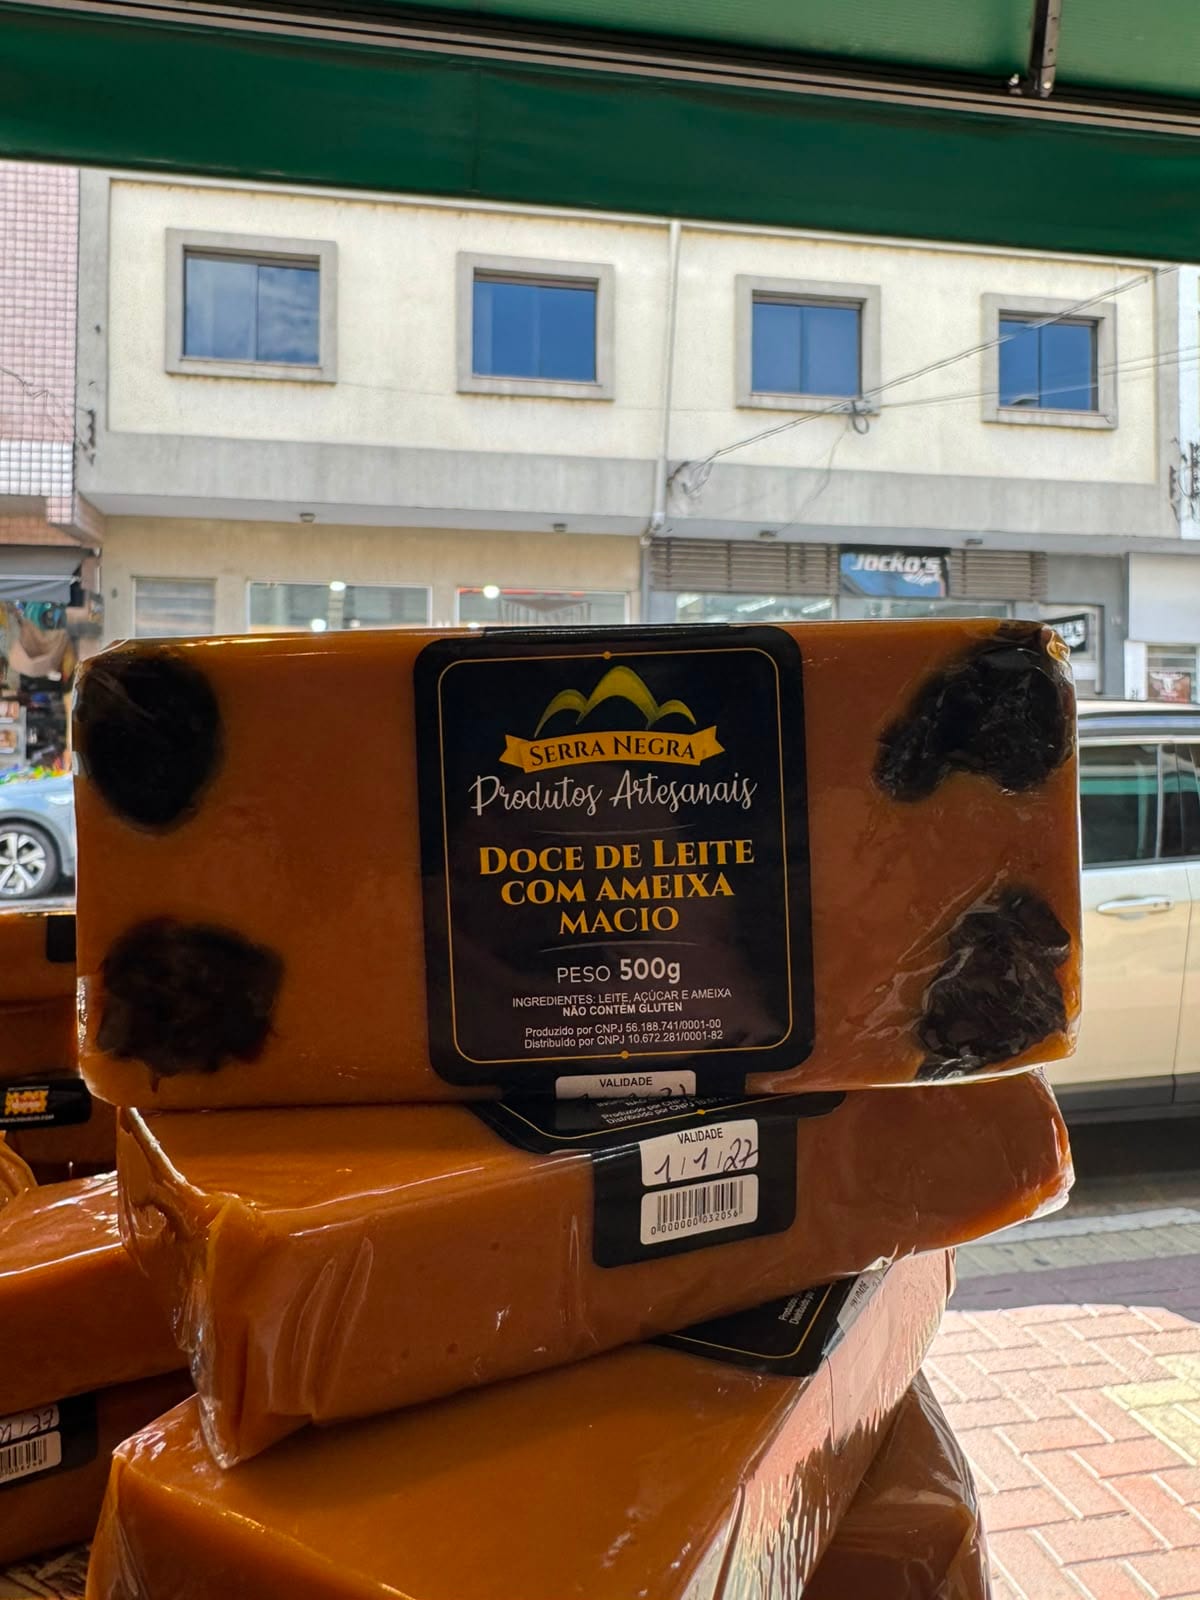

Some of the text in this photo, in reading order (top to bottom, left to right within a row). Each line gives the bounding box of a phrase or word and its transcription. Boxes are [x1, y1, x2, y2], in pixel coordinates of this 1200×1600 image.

[529, 735, 696, 767] SERRA NEGRA
[468, 769, 758, 817] Produtos Artesanais
[479, 839, 755, 875] DOCE DE LEITE
[501, 872, 735, 905] COM AMEIXA
[559, 906, 680, 935] MACIO
[557, 957, 681, 984] PESO 500g
[512, 995, 597, 1008] INGREDIENTES:
[633, 989, 679, 1004] AÇÚCAR
[681, 990, 688, 1000] E
[690, 988, 732, 1000] AMEIXA
[563, 1002, 683, 1017] NÃO CONTÉM GLUTEN
[525, 1024, 575, 1038] Produzido
[576, 1026, 592, 1037] por
[594, 1024, 623, 1035] CNPJ
[578, 1037, 594, 1048] por
[596, 1034, 625, 1045] CNPJ
[599, 1076, 653, 1089] VALIDADE
[677, 1127, 723, 1144] VALIDADE
